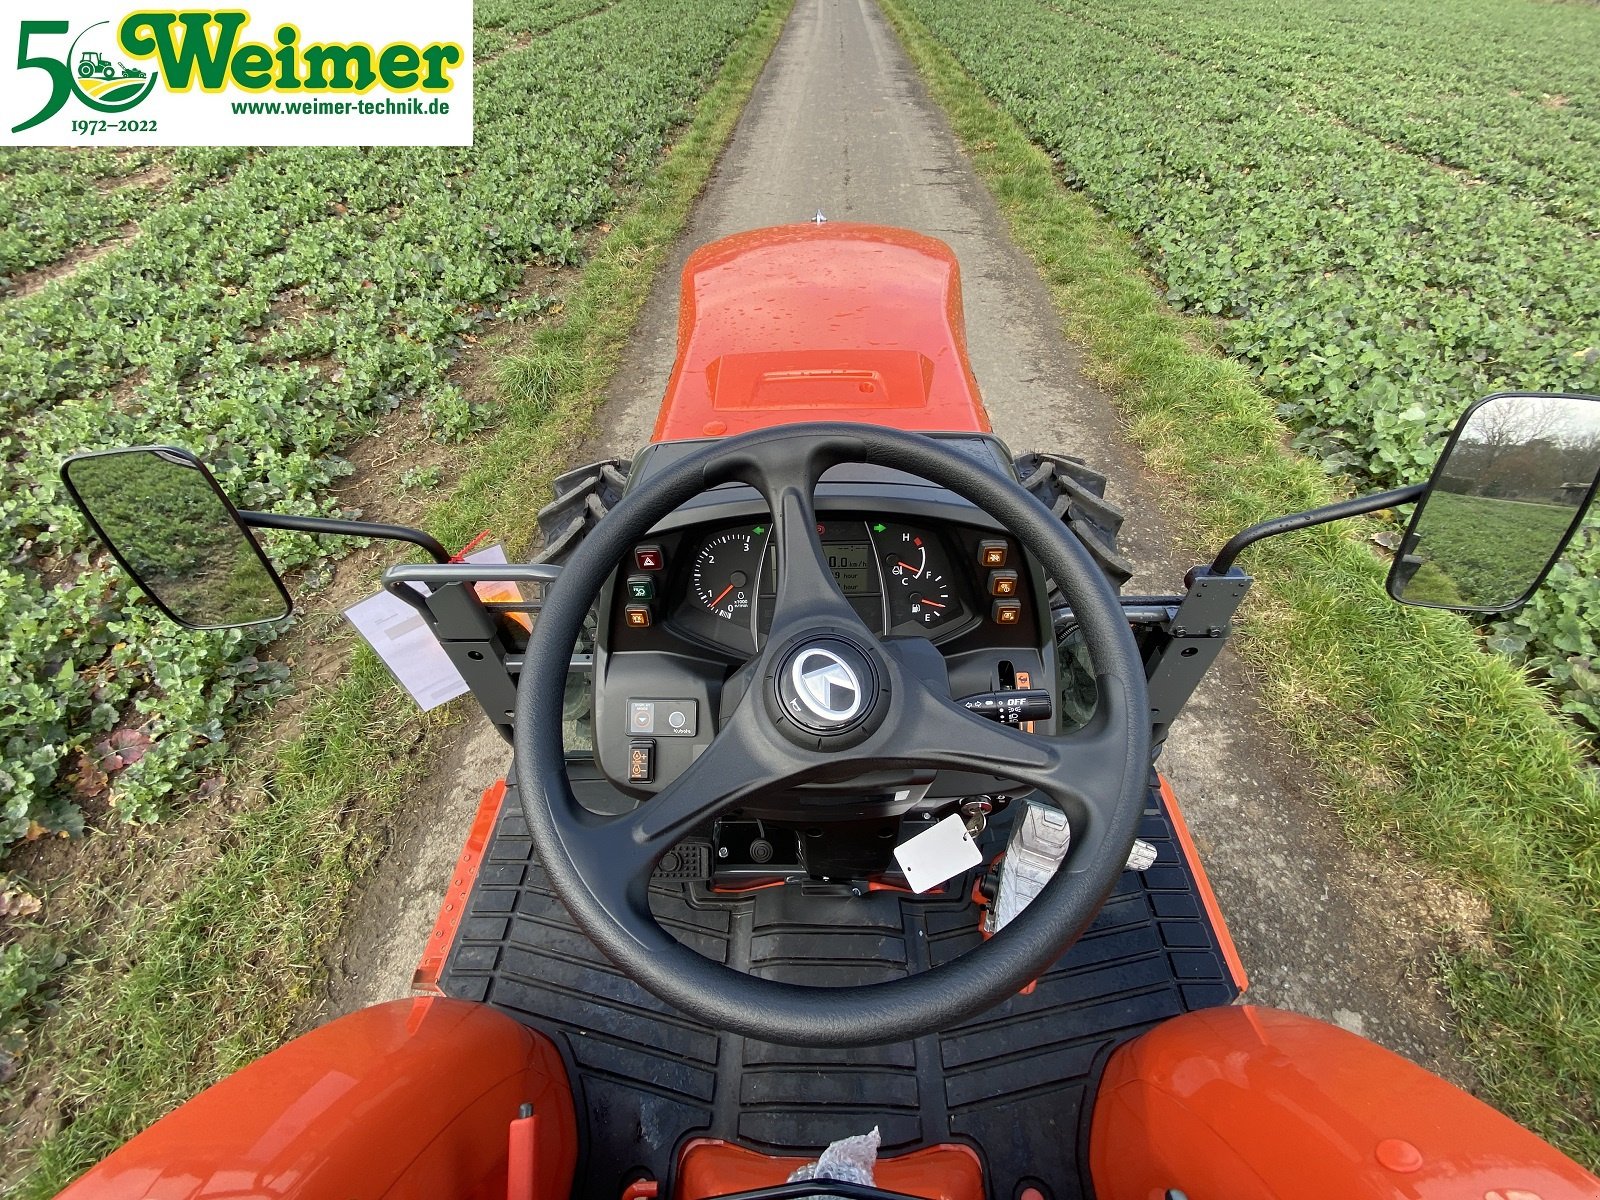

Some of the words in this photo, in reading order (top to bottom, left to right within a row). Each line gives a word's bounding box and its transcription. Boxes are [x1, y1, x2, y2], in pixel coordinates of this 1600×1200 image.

[902, 533, 910, 542] H
[743, 543, 750, 552] 3
[708, 555, 715, 564] 2
[850, 560, 867, 568] km/h
[926, 571, 932, 580] F
[901, 578, 909, 586] C
[707, 589, 713, 598] 1
[727, 604, 734, 613] 0
[924, 613, 931, 622] E
[1007, 698, 1027, 706] OFF
